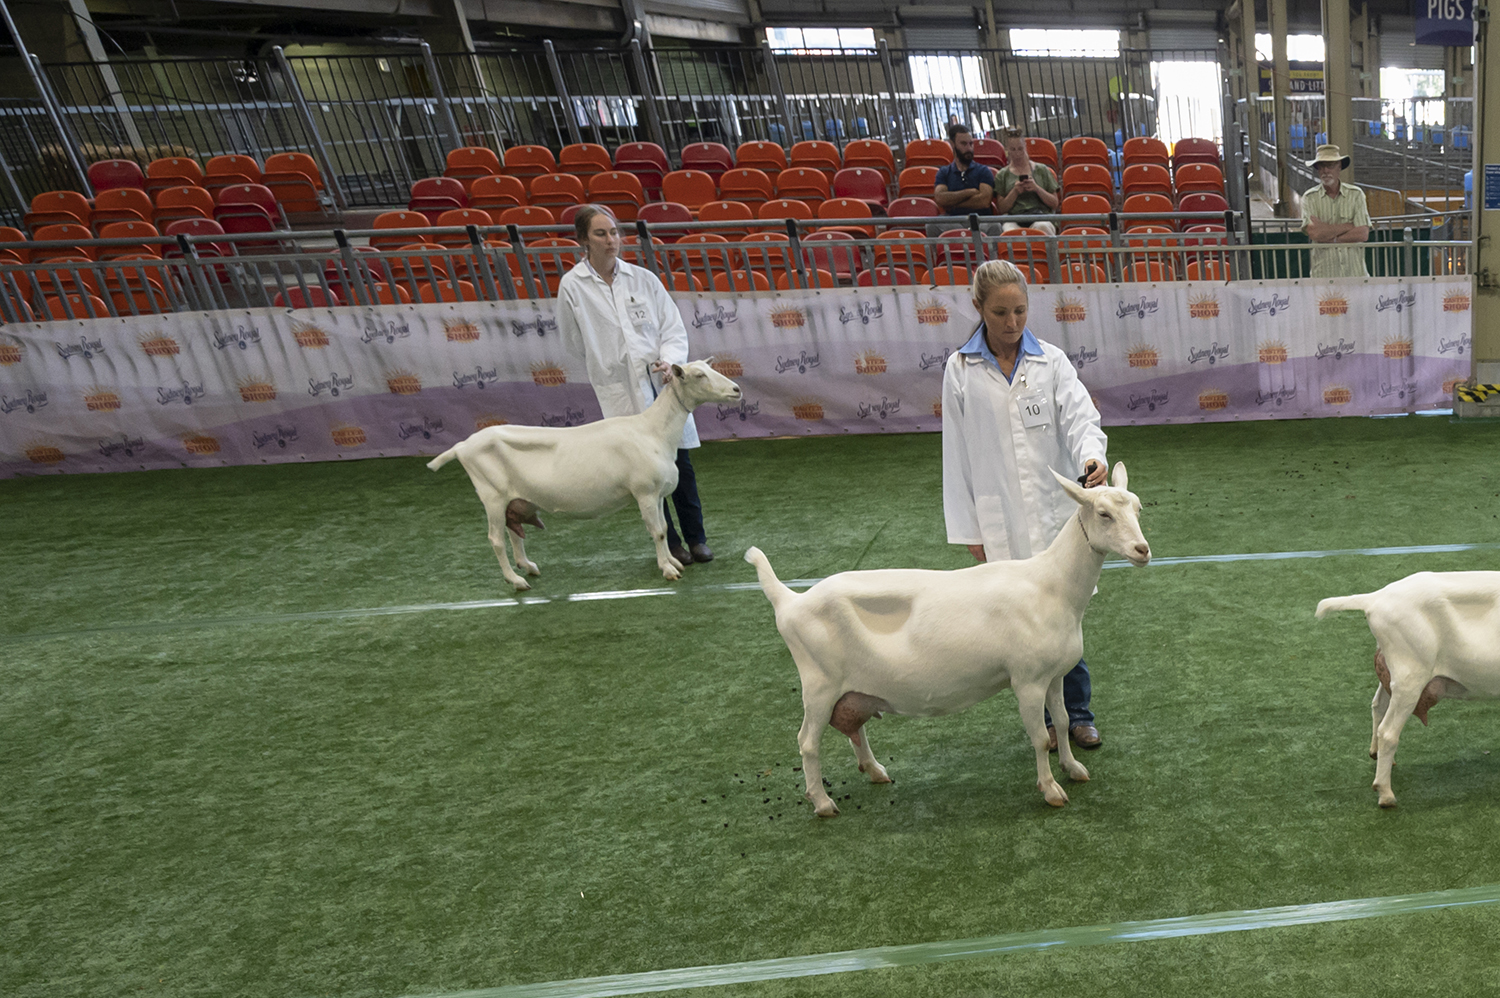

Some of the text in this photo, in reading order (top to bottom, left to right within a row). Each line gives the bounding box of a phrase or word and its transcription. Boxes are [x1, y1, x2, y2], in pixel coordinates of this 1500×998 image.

[1428, 0, 1464, 20] PIGS
[1308, 80, 1324, 91] LITT
[1116, 296, 1159, 318] Sydney Royal
[1248, 294, 1290, 315] Sydney Royal
[1376, 290, 1416, 312] Sydney Royal
[1443, 303, 1470, 311] SHOW
[635, 310, 646, 319] 12
[692, 306, 739, 329] Sydney Royal
[1056, 313, 1086, 322] SHOW
[1191, 310, 1220, 318] SHOW
[1319, 307, 1348, 315] SHOW
[512, 314, 558, 336] Sydney Royal
[772, 318, 806, 328] SHOW
[918, 315, 949, 324] SHOW
[214, 325, 261, 350] Sydney Royal
[362, 321, 411, 343] Sydney Royal
[447, 332, 480, 342] SHOW
[58, 336, 105, 359] Sydney Royal
[297, 337, 330, 347] SHOW
[1315, 338, 1355, 359] Sydney Royal
[144, 346, 180, 356] SHOW
[1079, 346, 1098, 363] Royal
[1188, 342, 1230, 364] Sydney Royal
[1259, 354, 1287, 362] SHOW
[775, 351, 820, 374] Sydney Royal
[1129, 359, 1159, 367] SHOW
[308, 372, 354, 396] Sydney Royal
[453, 366, 499, 388] Sydney Royal
[534, 376, 567, 386] SHOW
[157, 380, 205, 405] Sydney Royal
[389, 384, 422, 394] SHOW
[1379, 377, 1417, 397] Sydney Royal
[1, 389, 48, 414] Sydney Royal
[242, 391, 277, 402] SHOW
[1127, 389, 1170, 410] Sydney Royal
[1256, 385, 1296, 406] Sydney Royal
[1324, 396, 1352, 404] SHOW
[86, 401, 121, 410] SHOW
[716, 399, 760, 420] Sydney Royal
[1026, 404, 1040, 416] 10
[1200, 401, 1228, 409] SHOW
[794, 412, 824, 420] SHOW
[399, 416, 445, 440] Sydney Royal
[253, 425, 299, 449] Sydney Royal
[334, 436, 366, 446] SHOW
[99, 434, 145, 457] Sydney Royal
[185, 444, 221, 454] SHOW
[29, 453, 66, 464] SHOW
